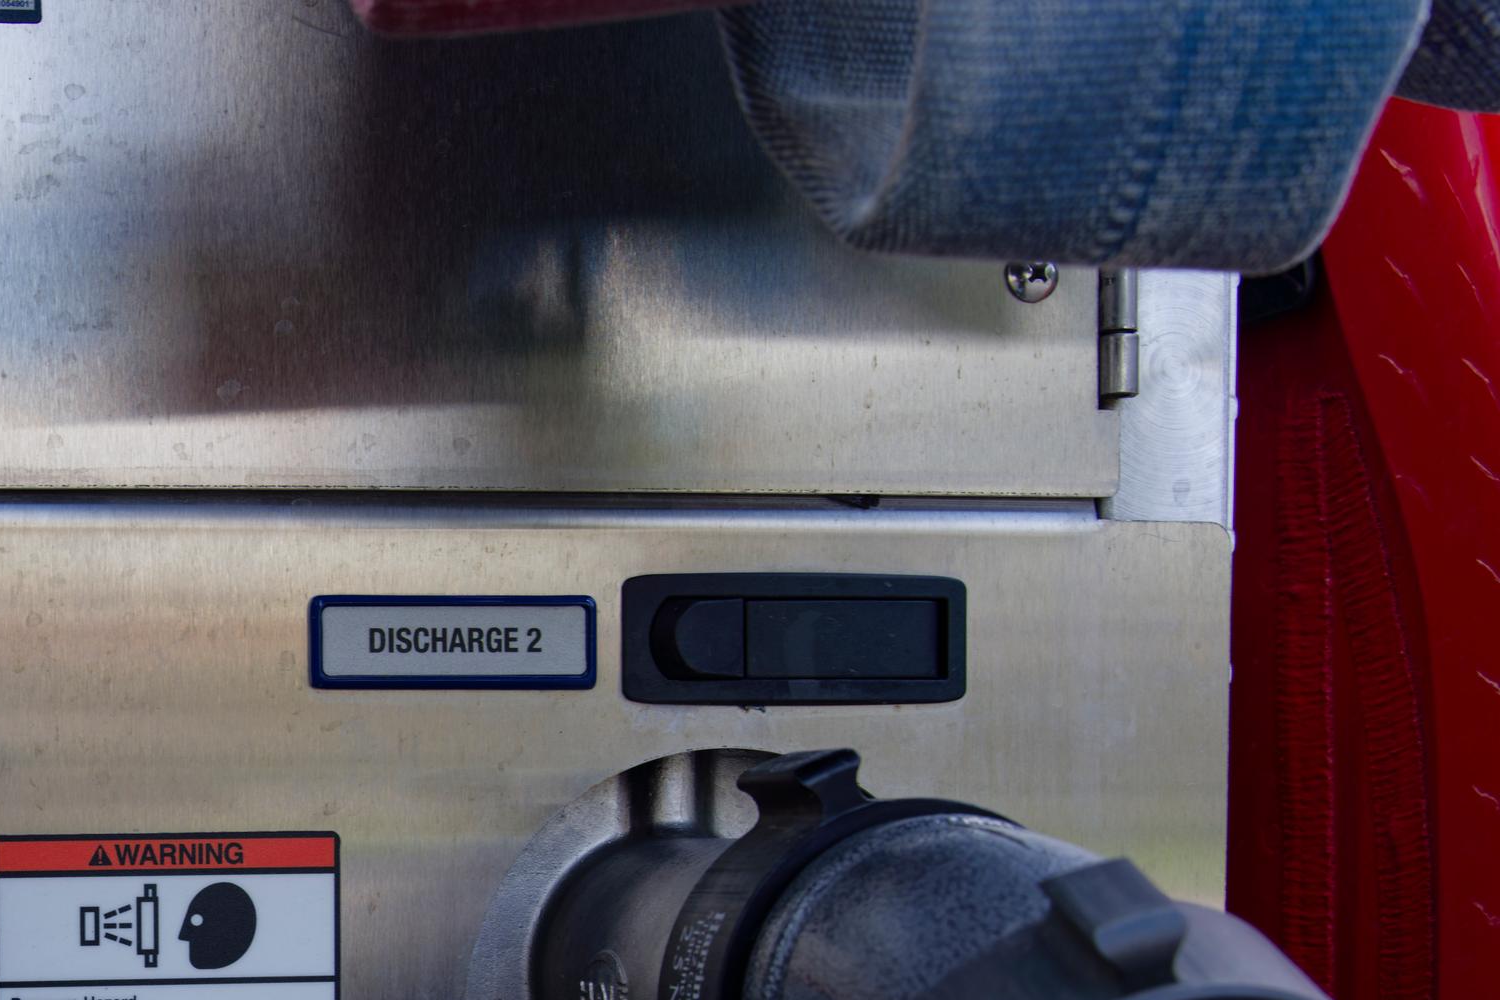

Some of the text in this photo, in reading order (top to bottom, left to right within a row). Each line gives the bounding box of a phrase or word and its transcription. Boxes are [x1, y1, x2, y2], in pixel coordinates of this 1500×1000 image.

[368, 628, 543, 654] DISCHARGE 2
[115, 843, 244, 865] WARNING
